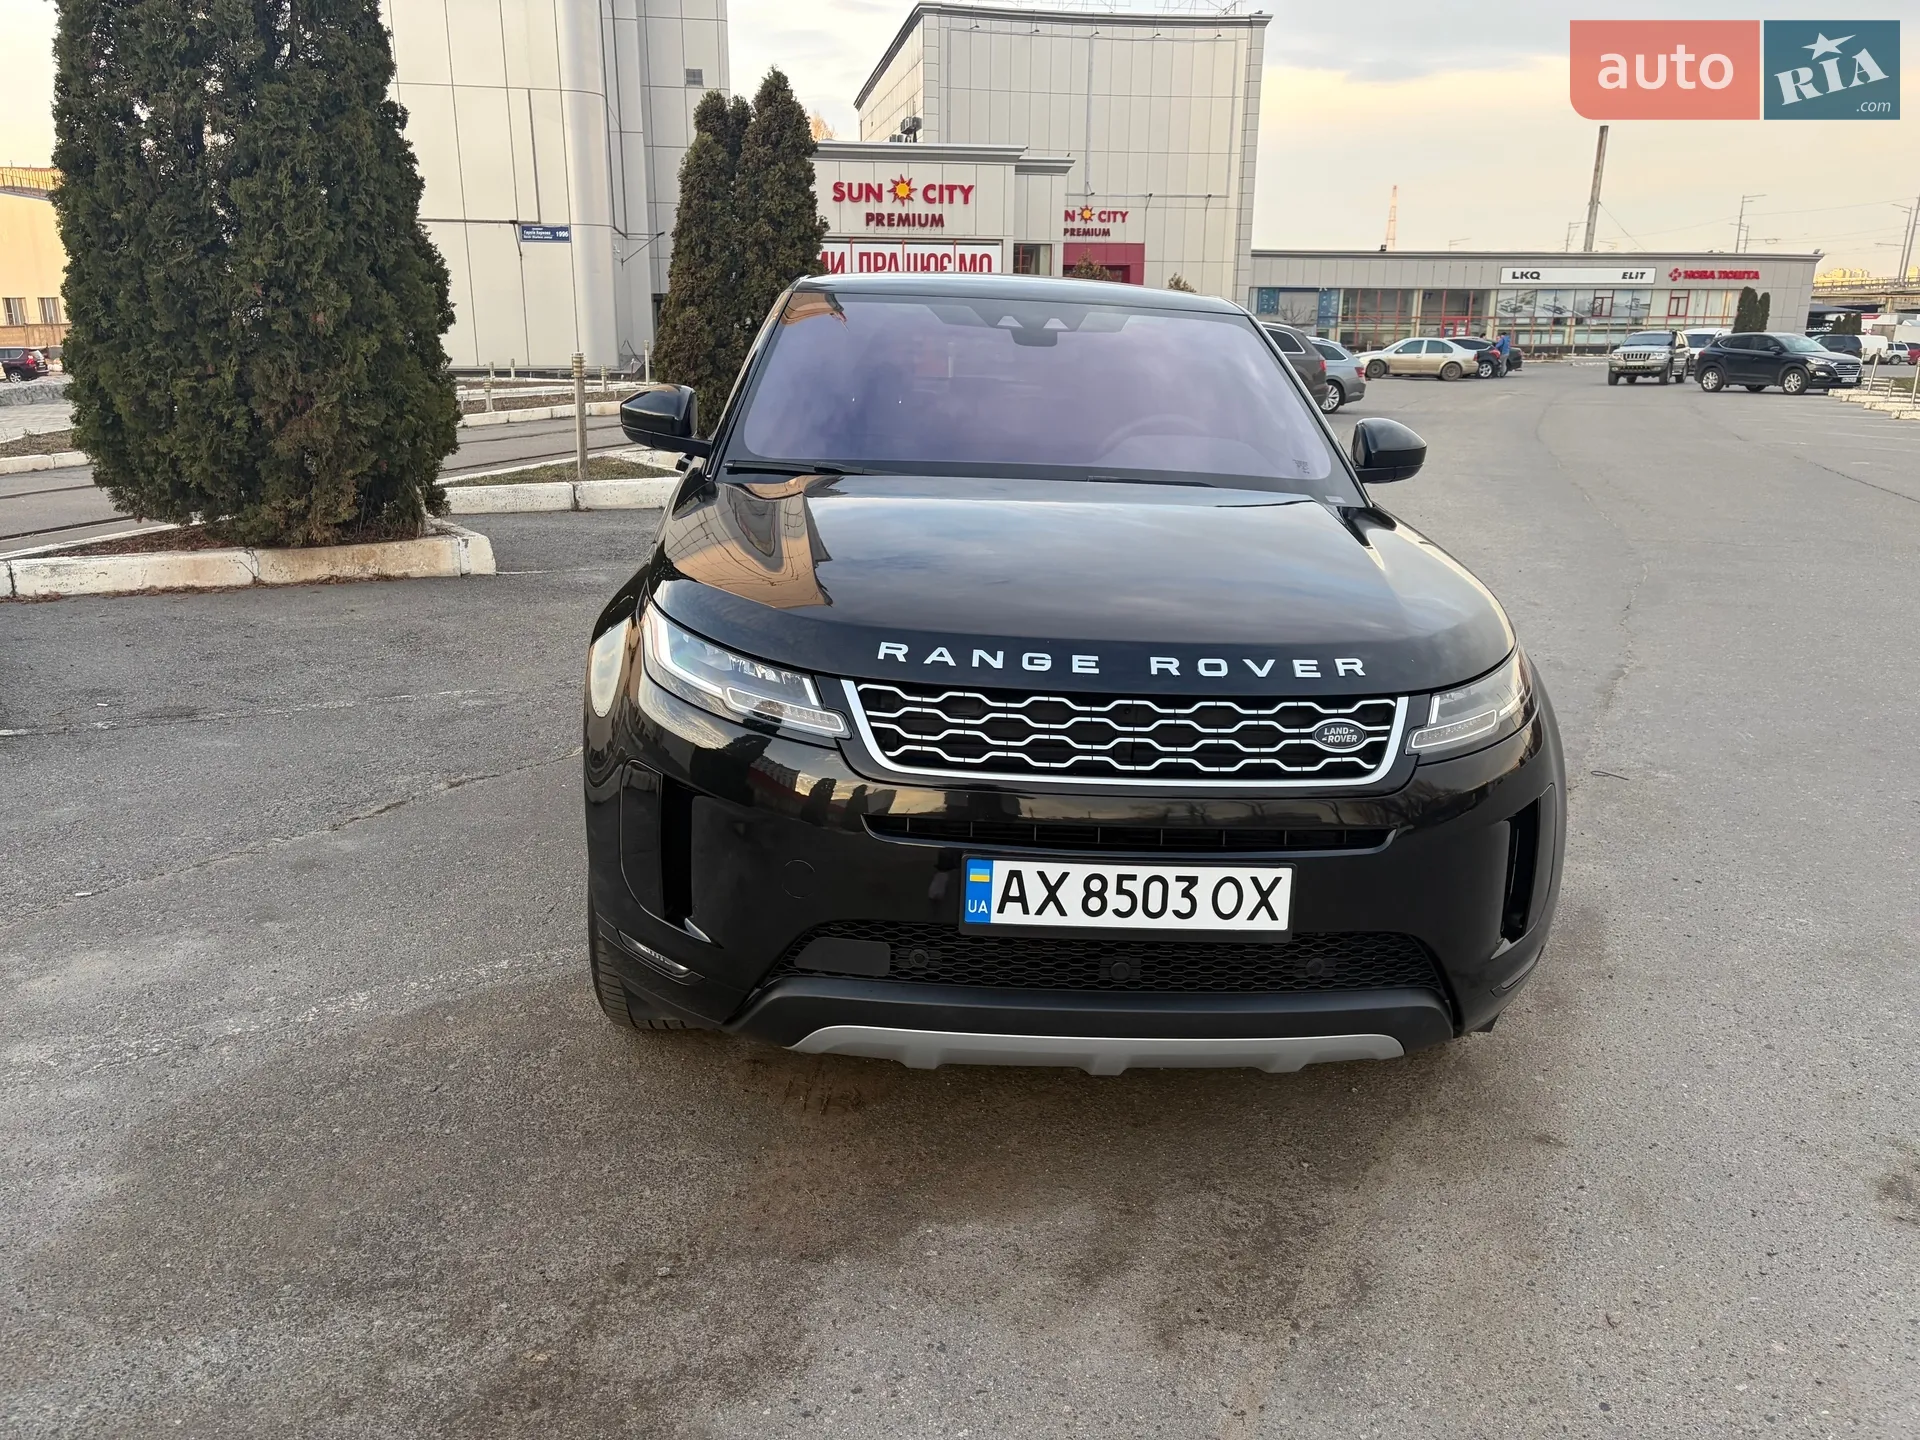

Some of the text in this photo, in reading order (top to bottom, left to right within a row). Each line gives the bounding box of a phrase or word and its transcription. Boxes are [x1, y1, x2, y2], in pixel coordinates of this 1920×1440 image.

[832, 181, 975, 205] SUN CITY
[865, 212, 945, 228] PREMIUM
[1098, 210, 1129, 223] CITY
[1063, 228, 1111, 237] PREMIUM
[1511, 271, 1541, 280] LKQ
[877, 641, 1366, 679] RANGE ROVER
[1324, 727, 1349, 736] LAND
[1327, 734, 1358, 743] ROVER
[996, 869, 1283, 921] AX 8503 OX
[967, 899, 988, 914] UA
